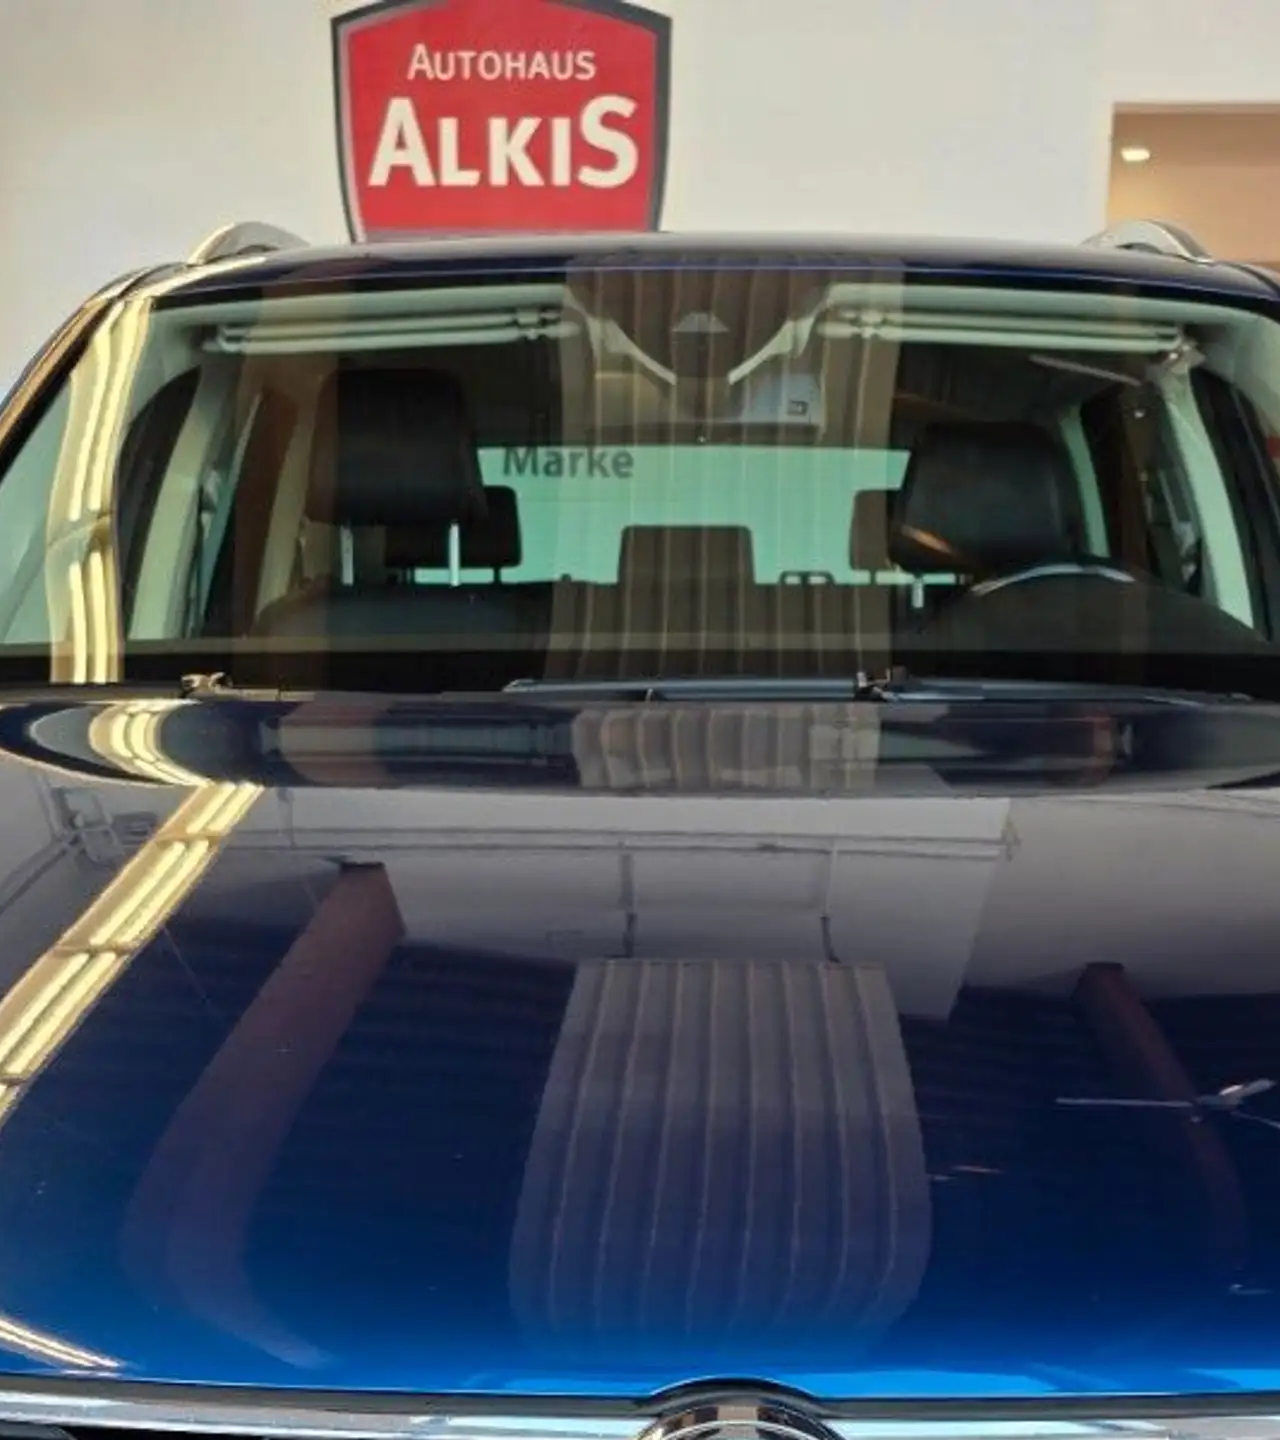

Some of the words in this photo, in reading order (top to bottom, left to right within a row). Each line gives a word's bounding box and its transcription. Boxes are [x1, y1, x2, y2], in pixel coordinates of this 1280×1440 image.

[407, 43, 596, 81] AUTOHAUS
[367, 94, 639, 188] ALKIS
[503, 444, 634, 478] Marke
